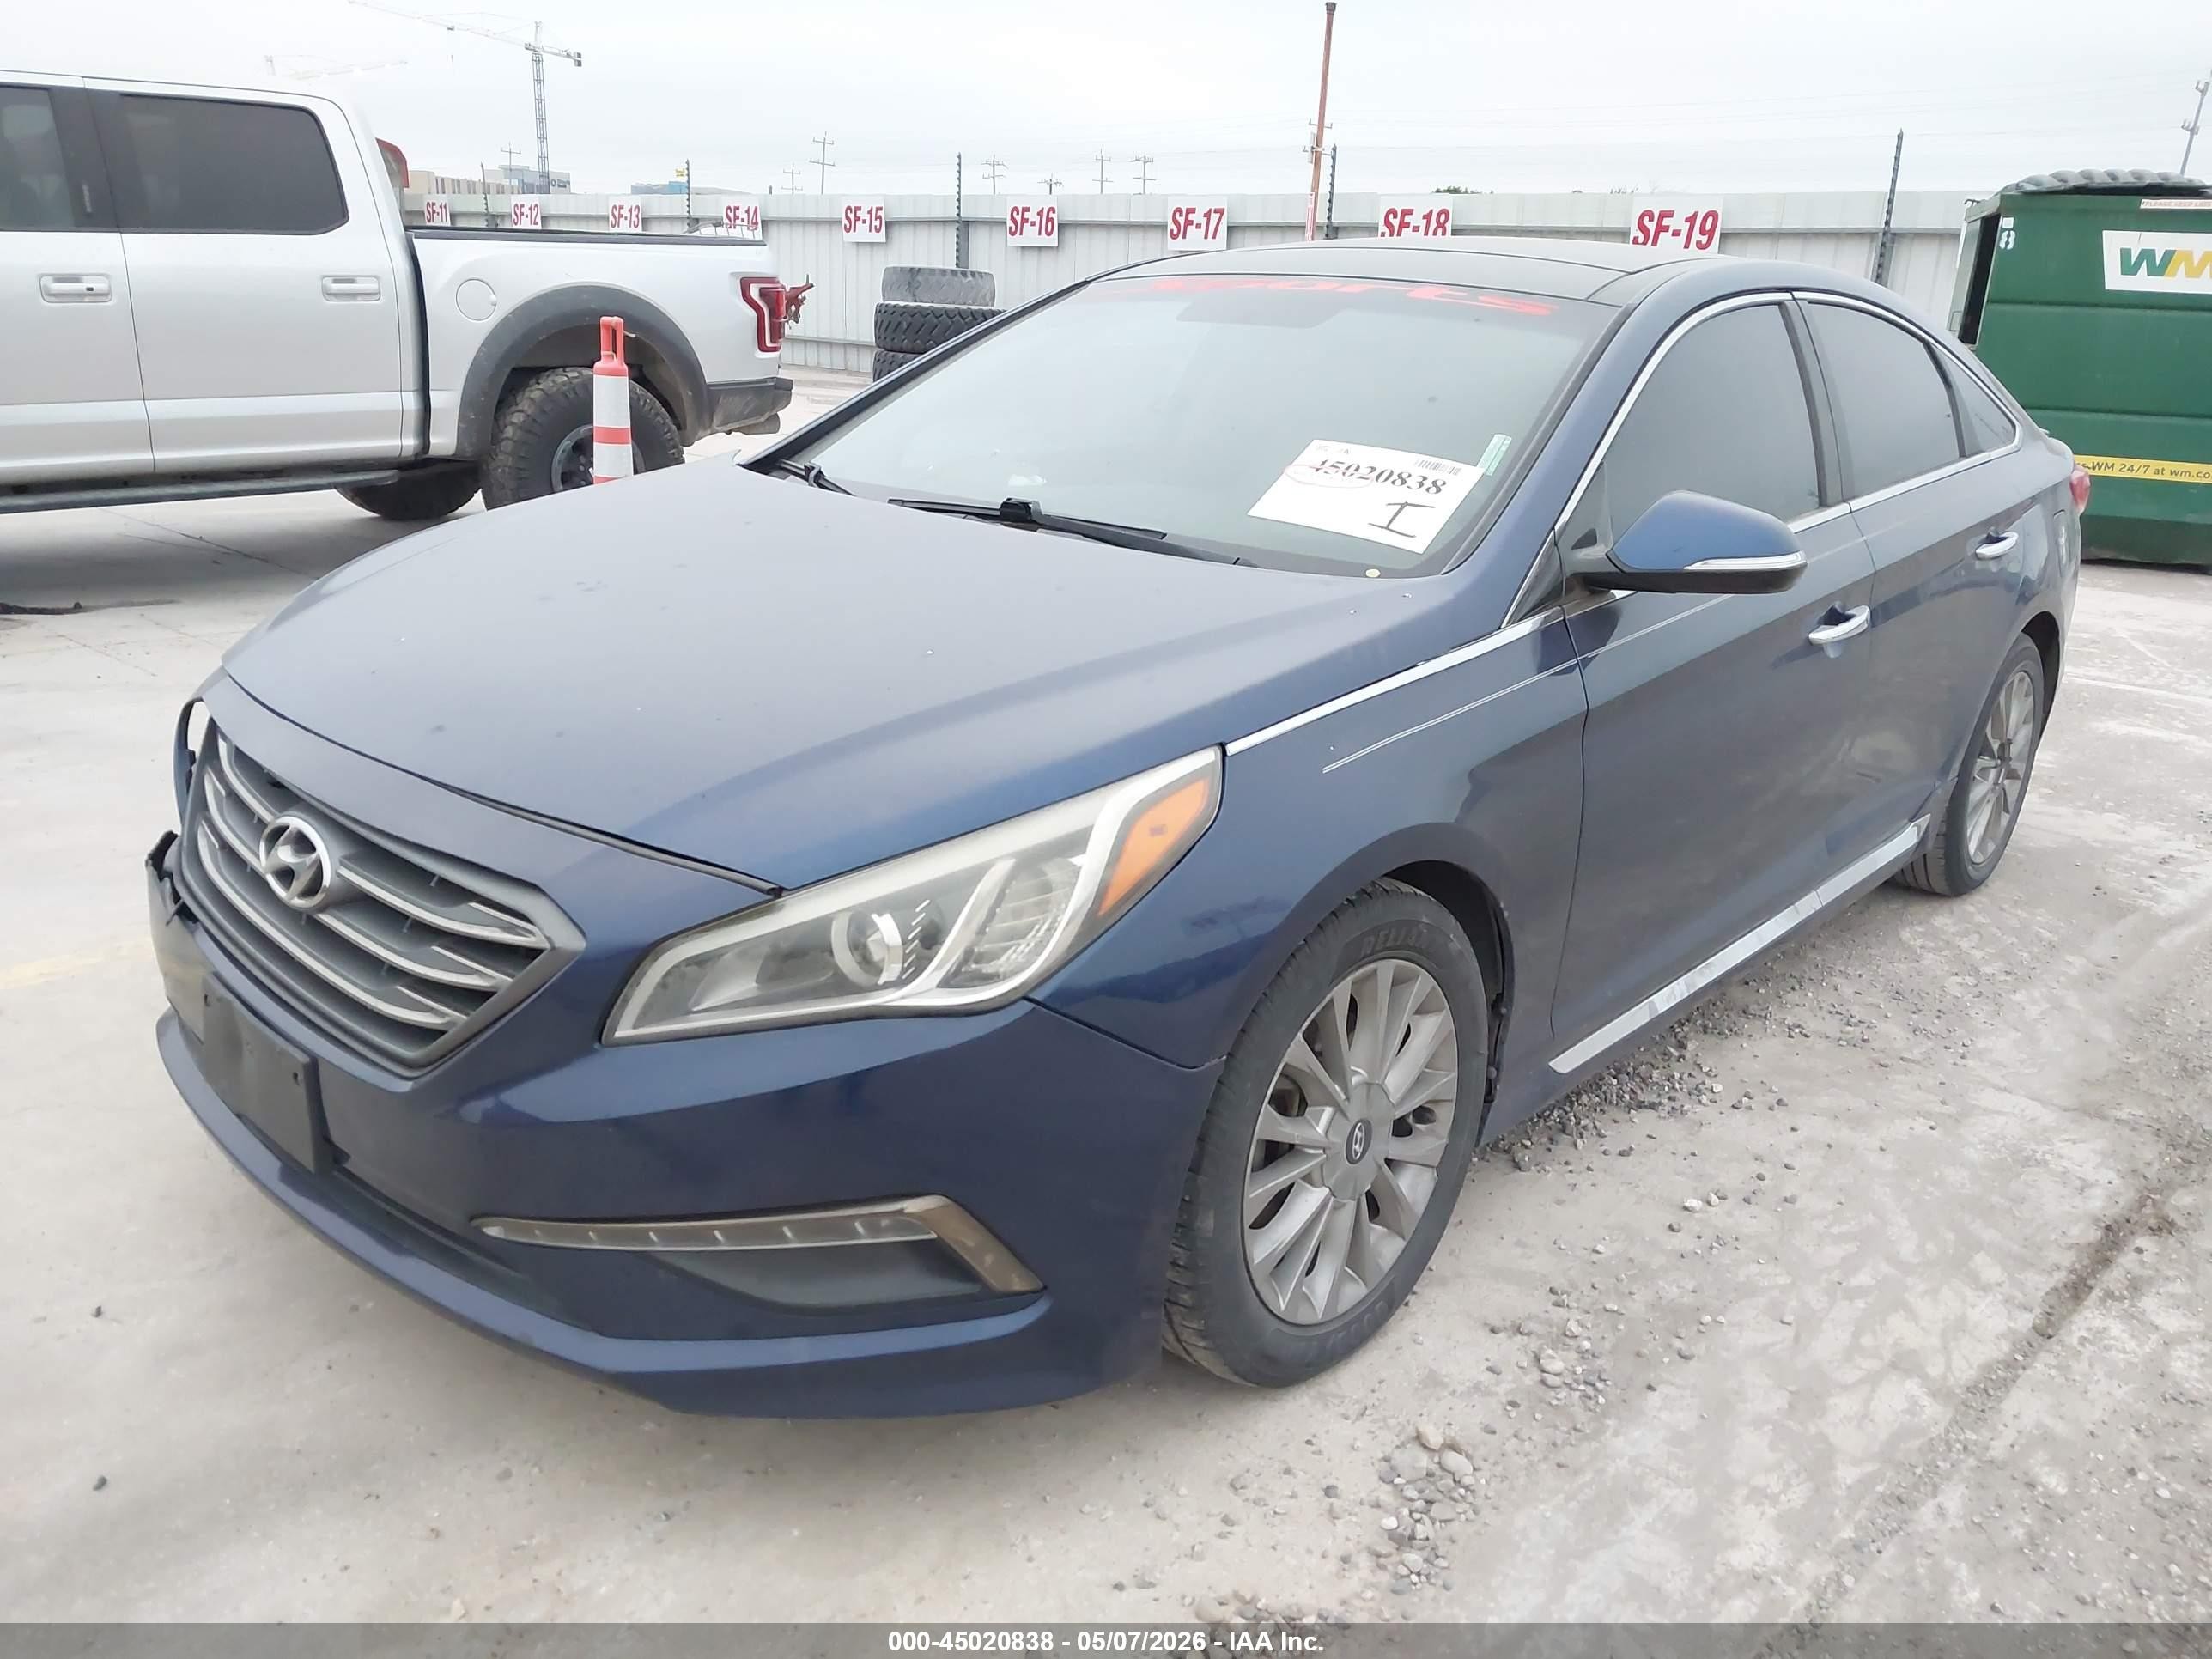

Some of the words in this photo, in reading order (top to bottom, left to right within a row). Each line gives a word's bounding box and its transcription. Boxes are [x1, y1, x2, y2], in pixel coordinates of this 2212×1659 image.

[426, 202, 447, 222] SF-11
[513, 204, 538, 225] SF-12
[611, 204, 640, 228] SF-13
[726, 205, 758, 230] SF-14
[842, 206, 883, 234] SF-15
[1009, 206, 1056, 237] SF-16
[1170, 207, 1225, 240] SF-17
[1380, 208, 1449, 237] SF-18
[1632, 210, 1718, 250] SF-19
[2119, 247, 2212, 278] WM
[1310, 459, 1446, 495] 45020838
[2118, 463, 2150, 474] 24/7
[2170, 469, 2212, 478] wm.co
